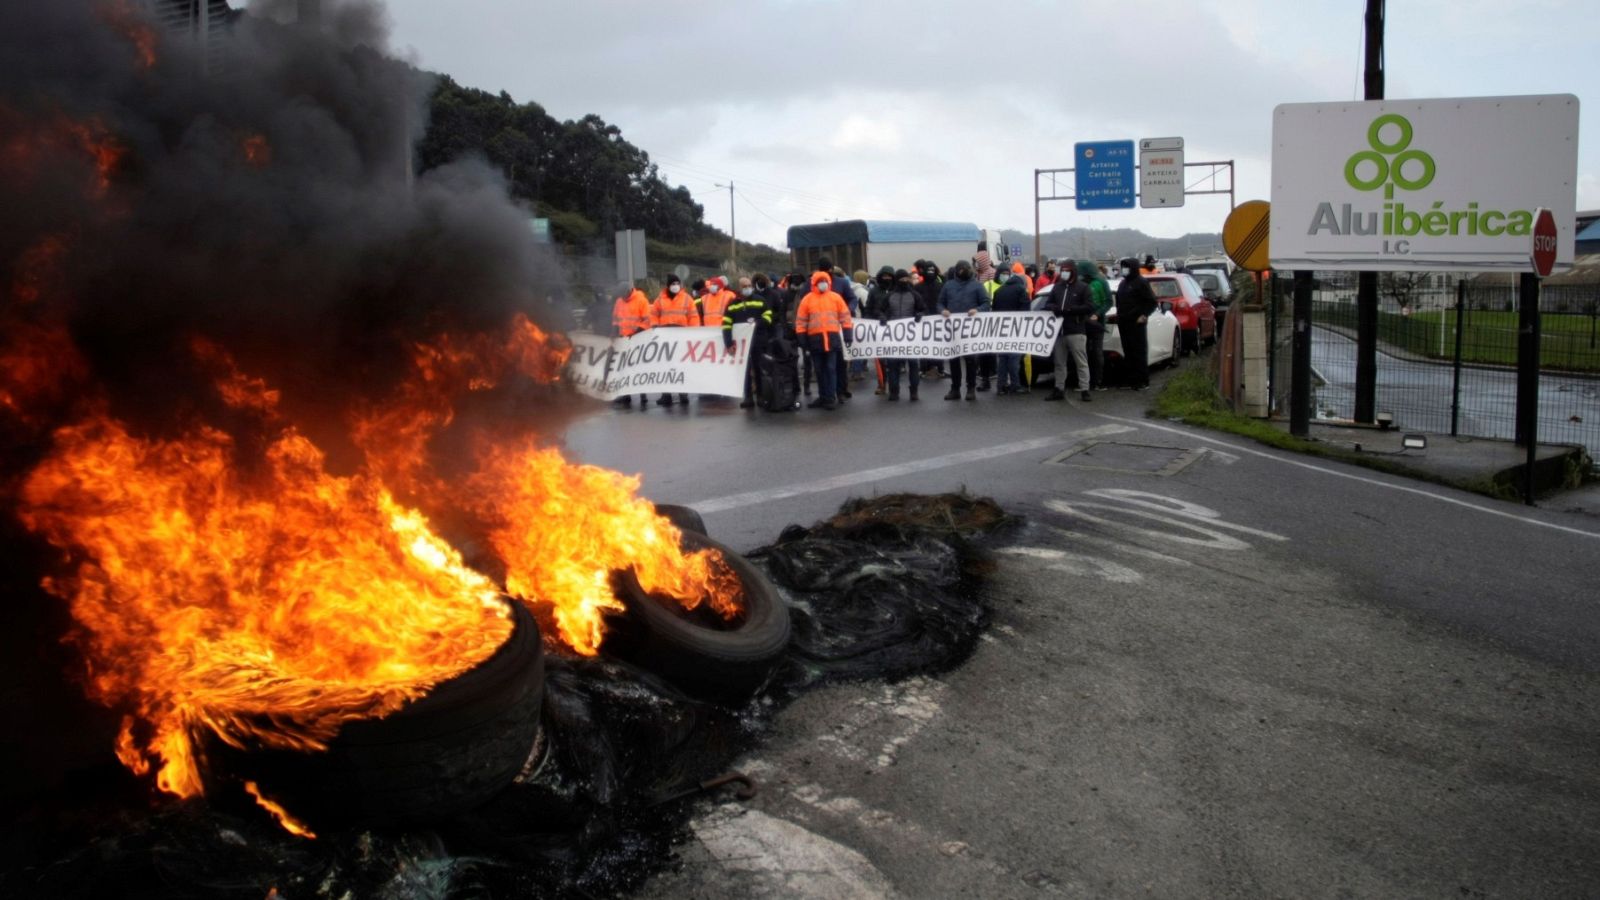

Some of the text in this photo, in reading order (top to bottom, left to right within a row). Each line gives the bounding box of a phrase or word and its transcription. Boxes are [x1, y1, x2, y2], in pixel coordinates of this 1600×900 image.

[1307, 201, 1533, 237] Aluibérica
[1535, 235, 1556, 252] STOP
[854, 316, 1057, 343] ON AOS DESPEDIMENTOS
[876, 345, 930, 357] EMPREGO
[932, 344, 961, 357] DIGNO
[962, 343, 969, 354] E
[971, 341, 993, 352] CON
[995, 341, 1050, 355] DEREITOS
[632, 367, 686, 387] CORUÑA
